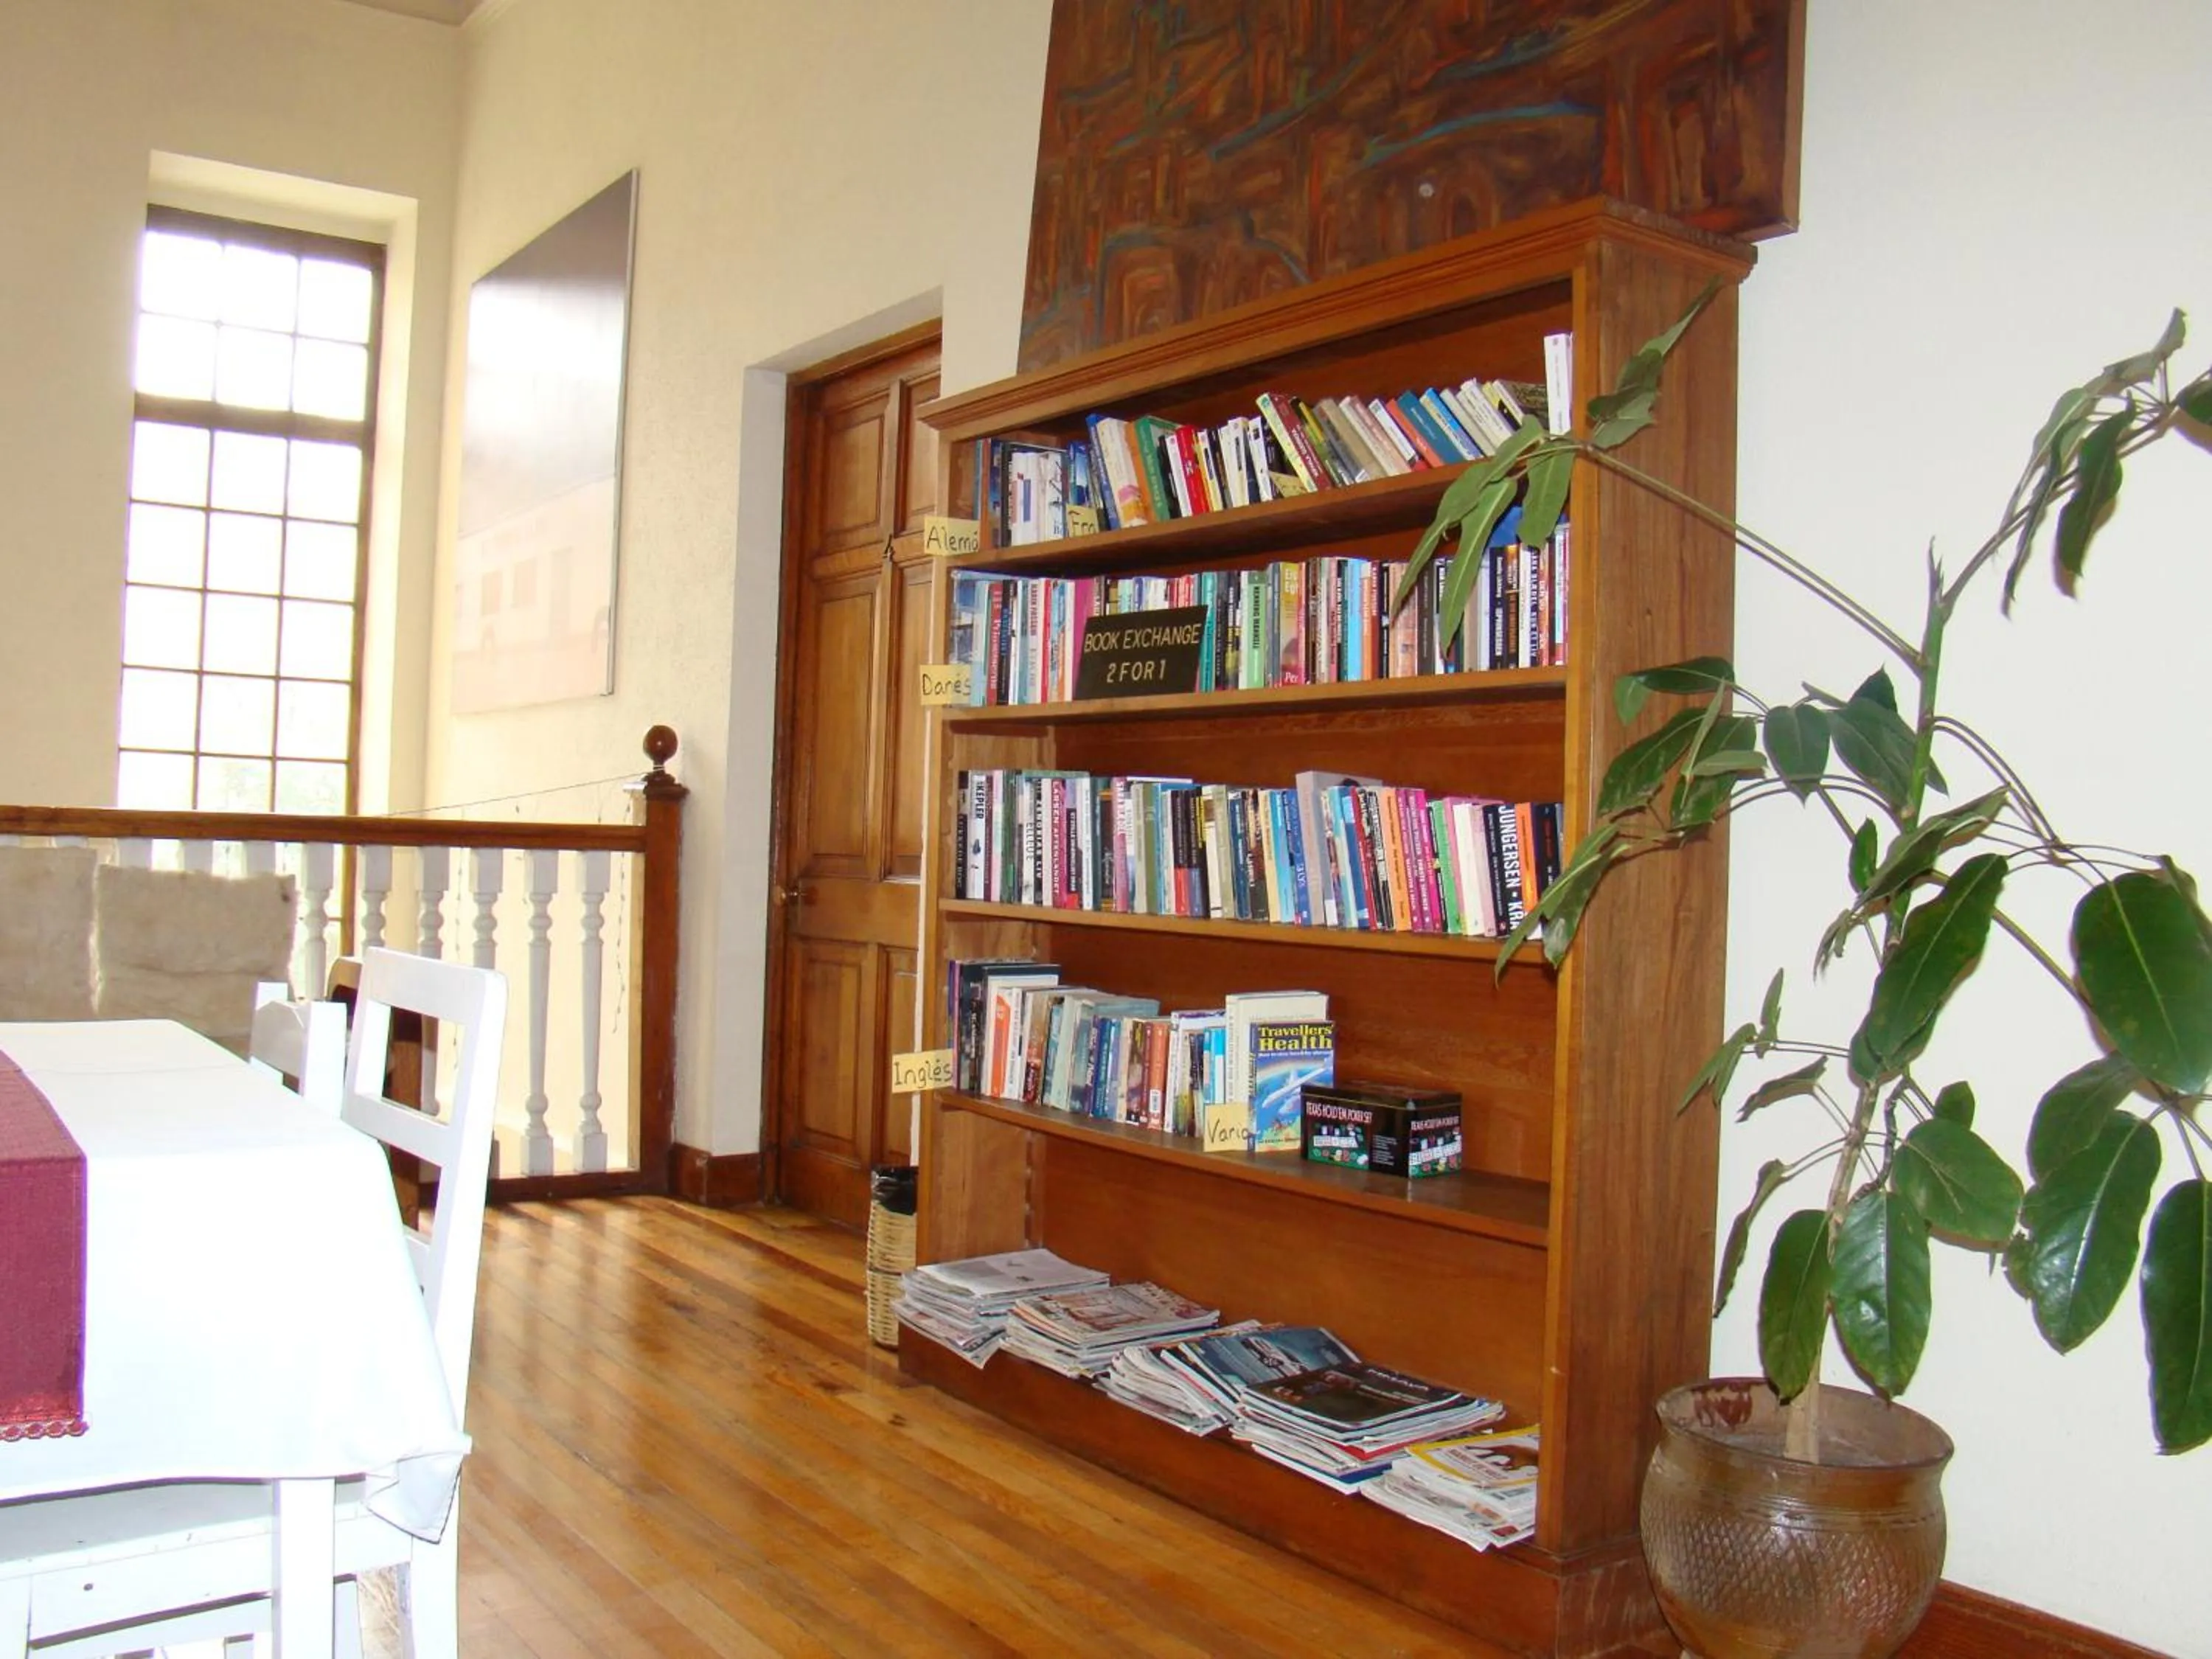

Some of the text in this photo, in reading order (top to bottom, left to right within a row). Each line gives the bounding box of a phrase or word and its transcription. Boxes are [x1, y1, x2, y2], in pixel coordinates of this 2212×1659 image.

[1084, 631, 1120, 653] BOOK
[1123, 623, 1203, 650] EXCHANGE
[1107, 659, 1166, 684] 2 FOR 1
[975, 785, 986, 820] KEPLER
[1052, 780, 1060, 894] LARSEN AFTENLANDET
[1498, 805, 1522, 888] JUNGERSEN
[1259, 1034, 1332, 1051] Health
